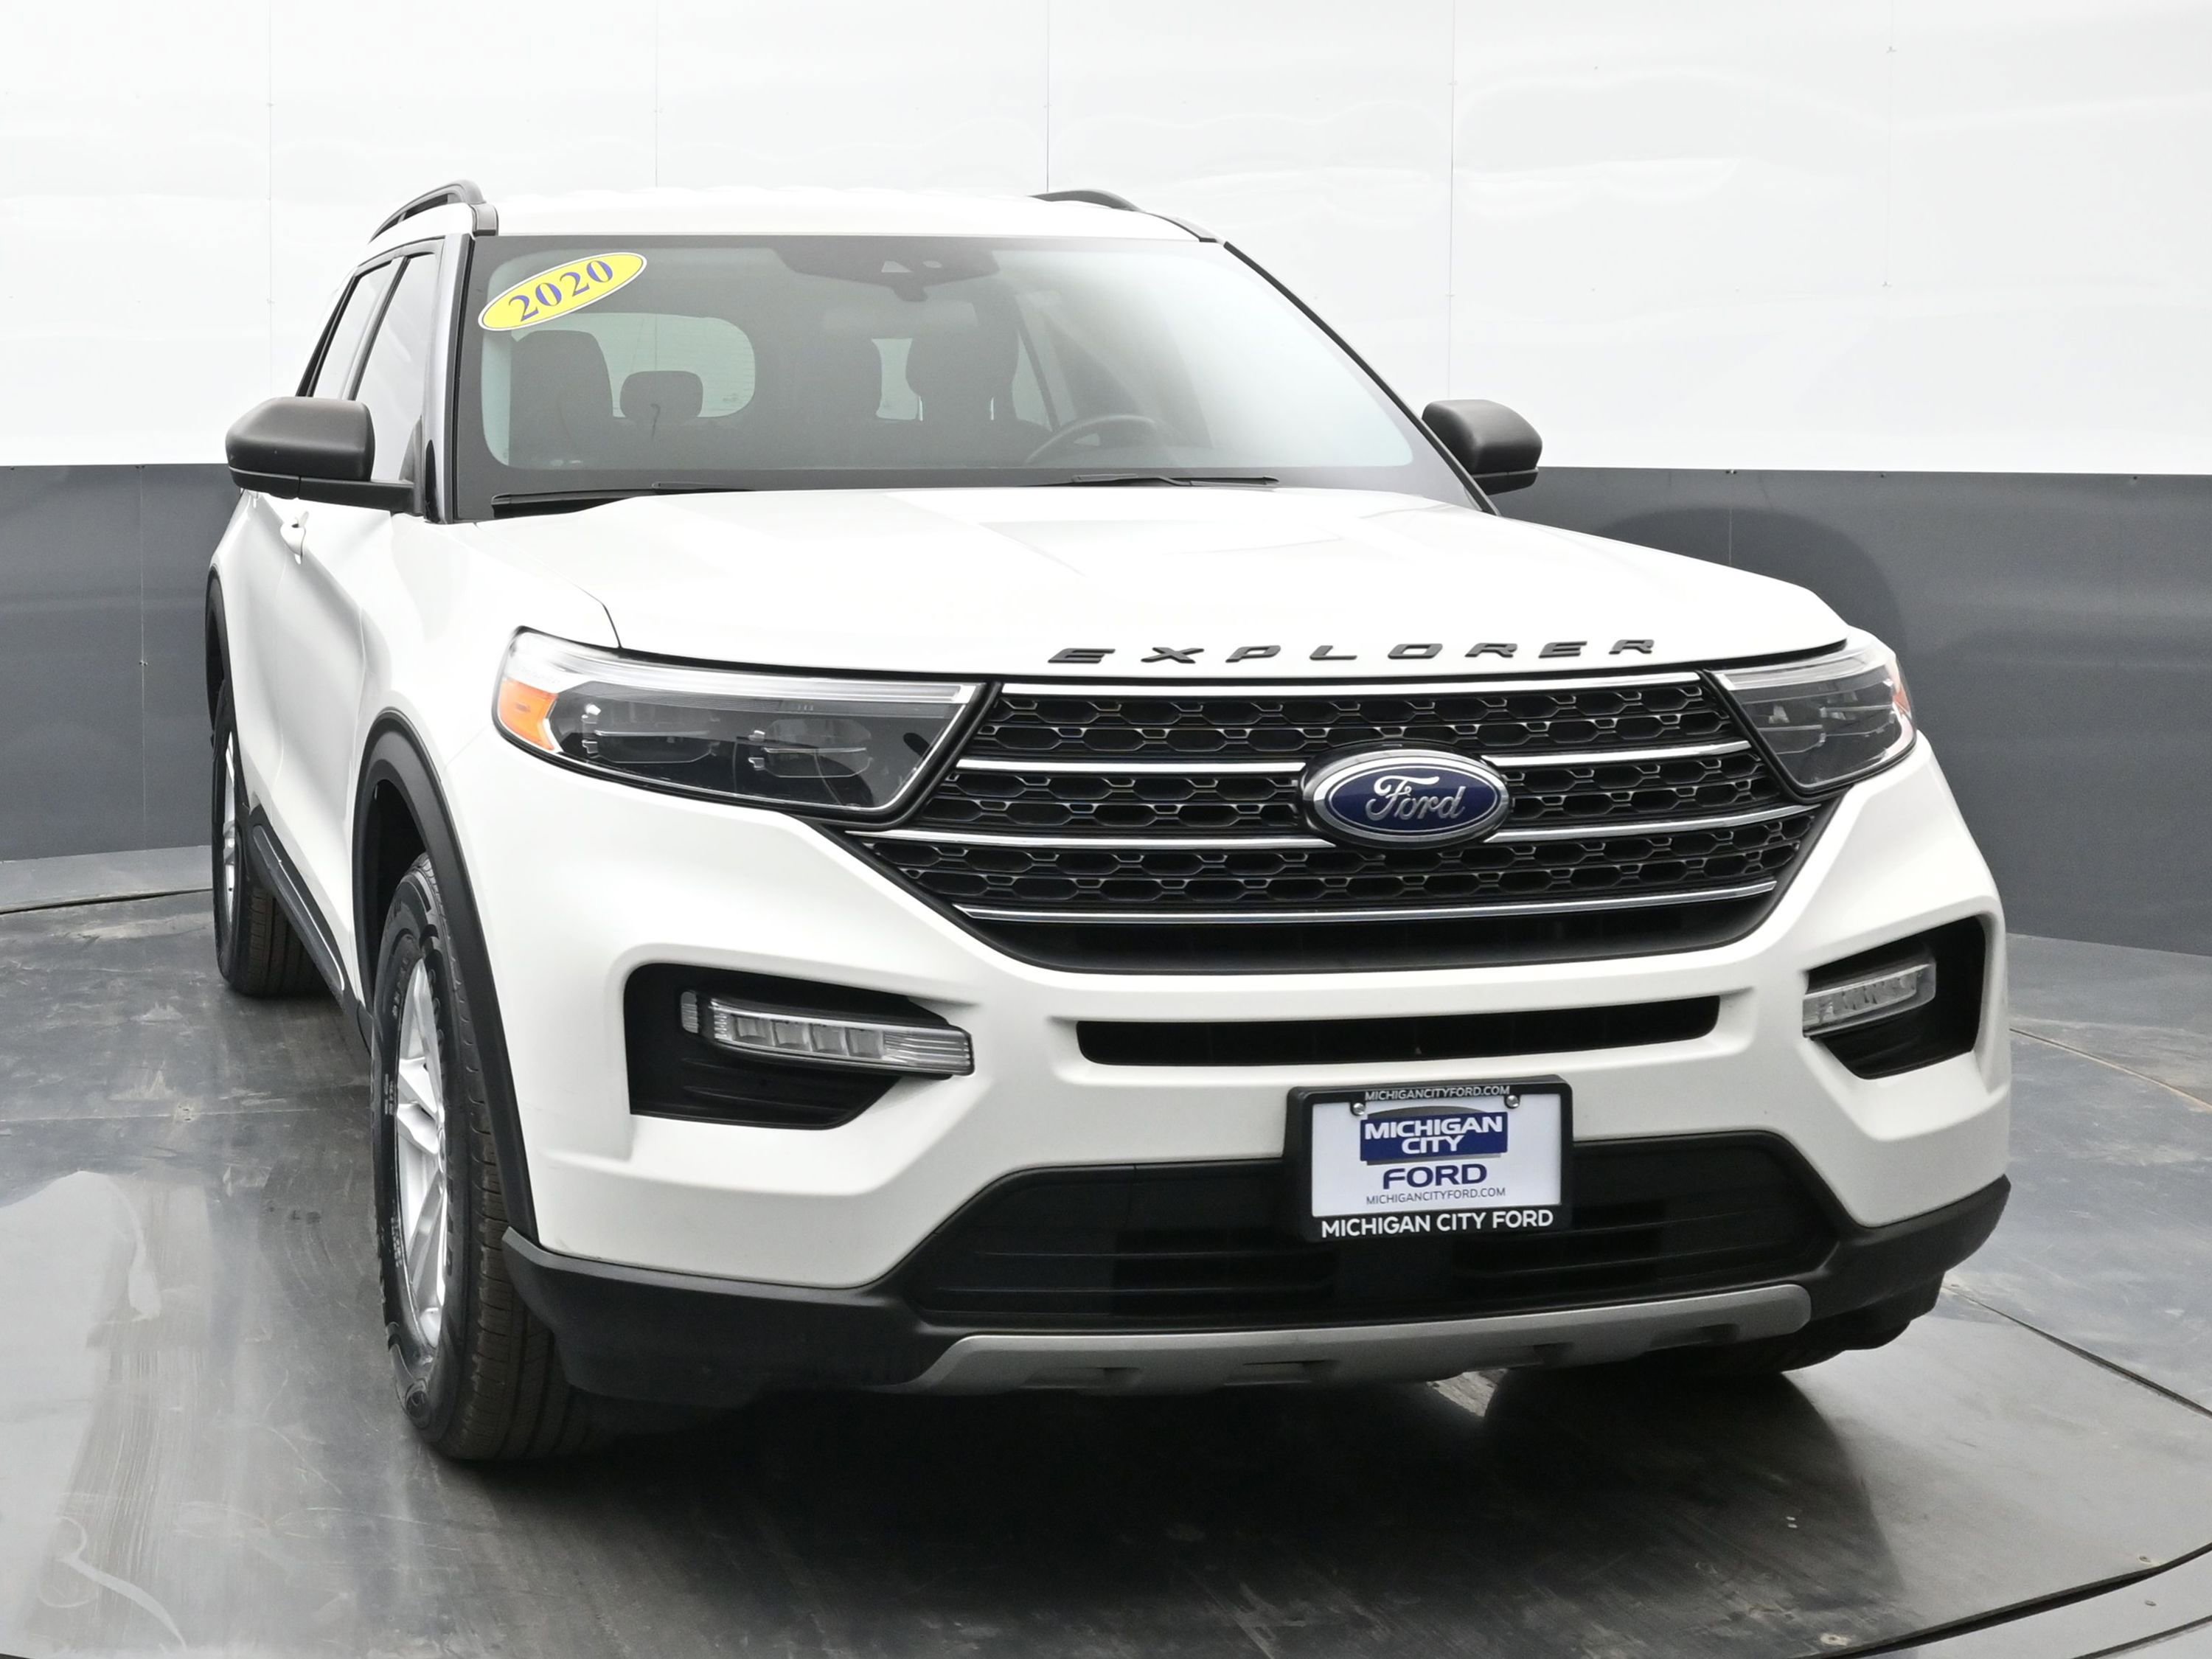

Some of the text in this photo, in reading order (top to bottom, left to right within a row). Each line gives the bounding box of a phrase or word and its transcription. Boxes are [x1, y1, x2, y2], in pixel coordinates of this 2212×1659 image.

[508, 260, 613, 322] 2020
[1047, 639, 1655, 664] EXPLORER
[1366, 775, 1466, 821] Ford
[1365, 1085, 1511, 1102] MICHIGANCITYFORD.COM
[1365, 1116, 1503, 1139] MICHIGAN
[1402, 1135, 1464, 1155] CITY
[1382, 1164, 1488, 1189] FORD
[1366, 1188, 1506, 1205] MICHIGANCITYFORD.COM
[1321, 1209, 1554, 1238] MICHIGAN CITY FORD
